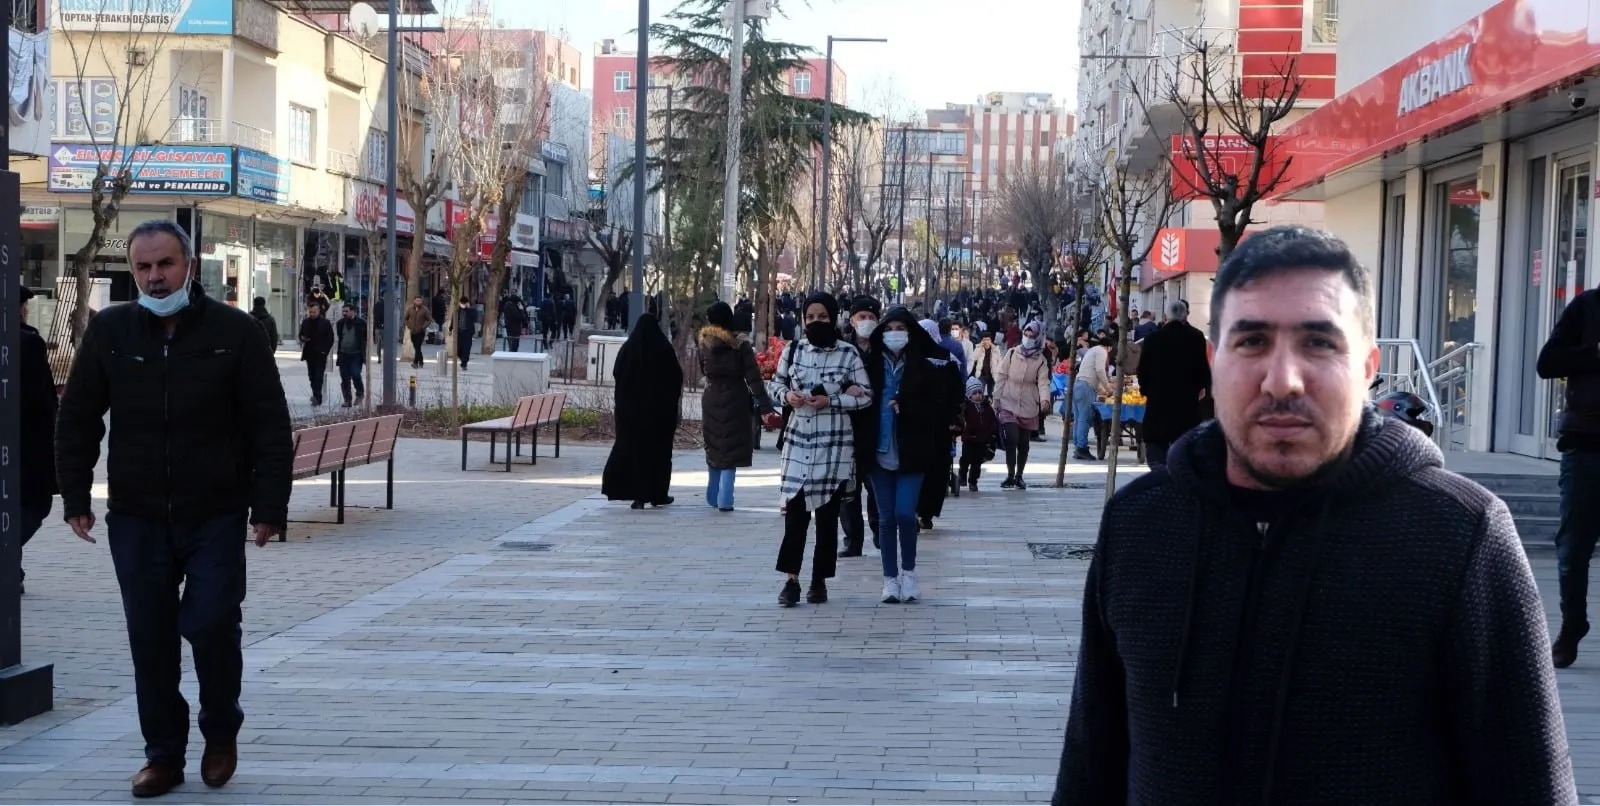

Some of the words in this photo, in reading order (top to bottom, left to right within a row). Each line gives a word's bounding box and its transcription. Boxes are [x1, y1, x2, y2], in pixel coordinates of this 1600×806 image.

[1397, 43, 1474, 117] AKBANK
[1182, 138, 1249, 148] ABANK
[163, 181, 226, 191] PERAKENDE
